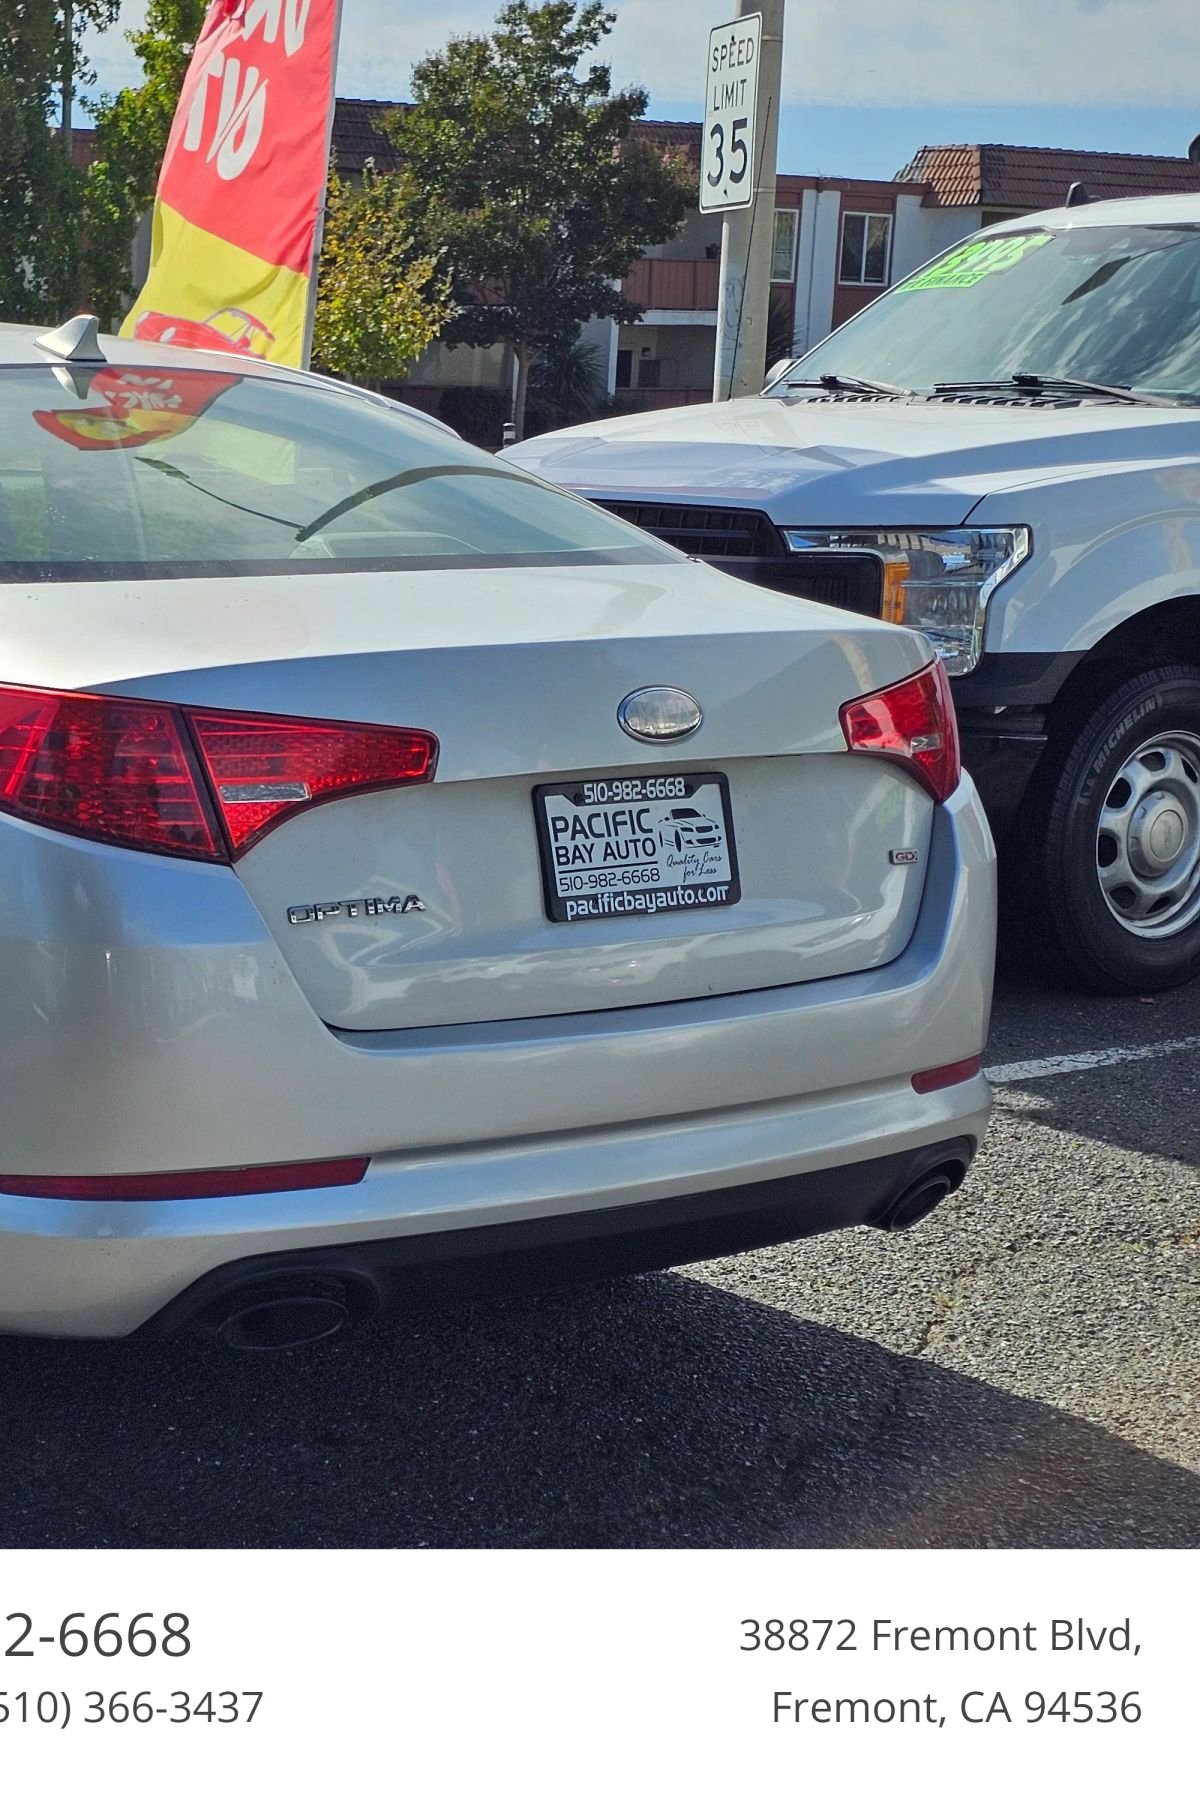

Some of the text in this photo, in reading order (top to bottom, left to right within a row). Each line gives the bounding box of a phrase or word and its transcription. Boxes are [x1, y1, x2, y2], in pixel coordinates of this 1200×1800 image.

[712, 37, 754, 72] SPEED
[713, 78, 747, 111] LIMIT
[707, 117, 748, 187] 35
[1093, 695, 1157, 775] MICHELIN
[583, 777, 686, 804] 510-982-6668
[551, 808, 654, 842] PACIFIC
[555, 837, 656, 867] BAY AUTO
[666, 851, 722, 871] Quality Cars
[558, 868, 661, 892] 510-982-6668
[683, 863, 717, 883] for Less
[286, 894, 427, 925] OPTIMA
